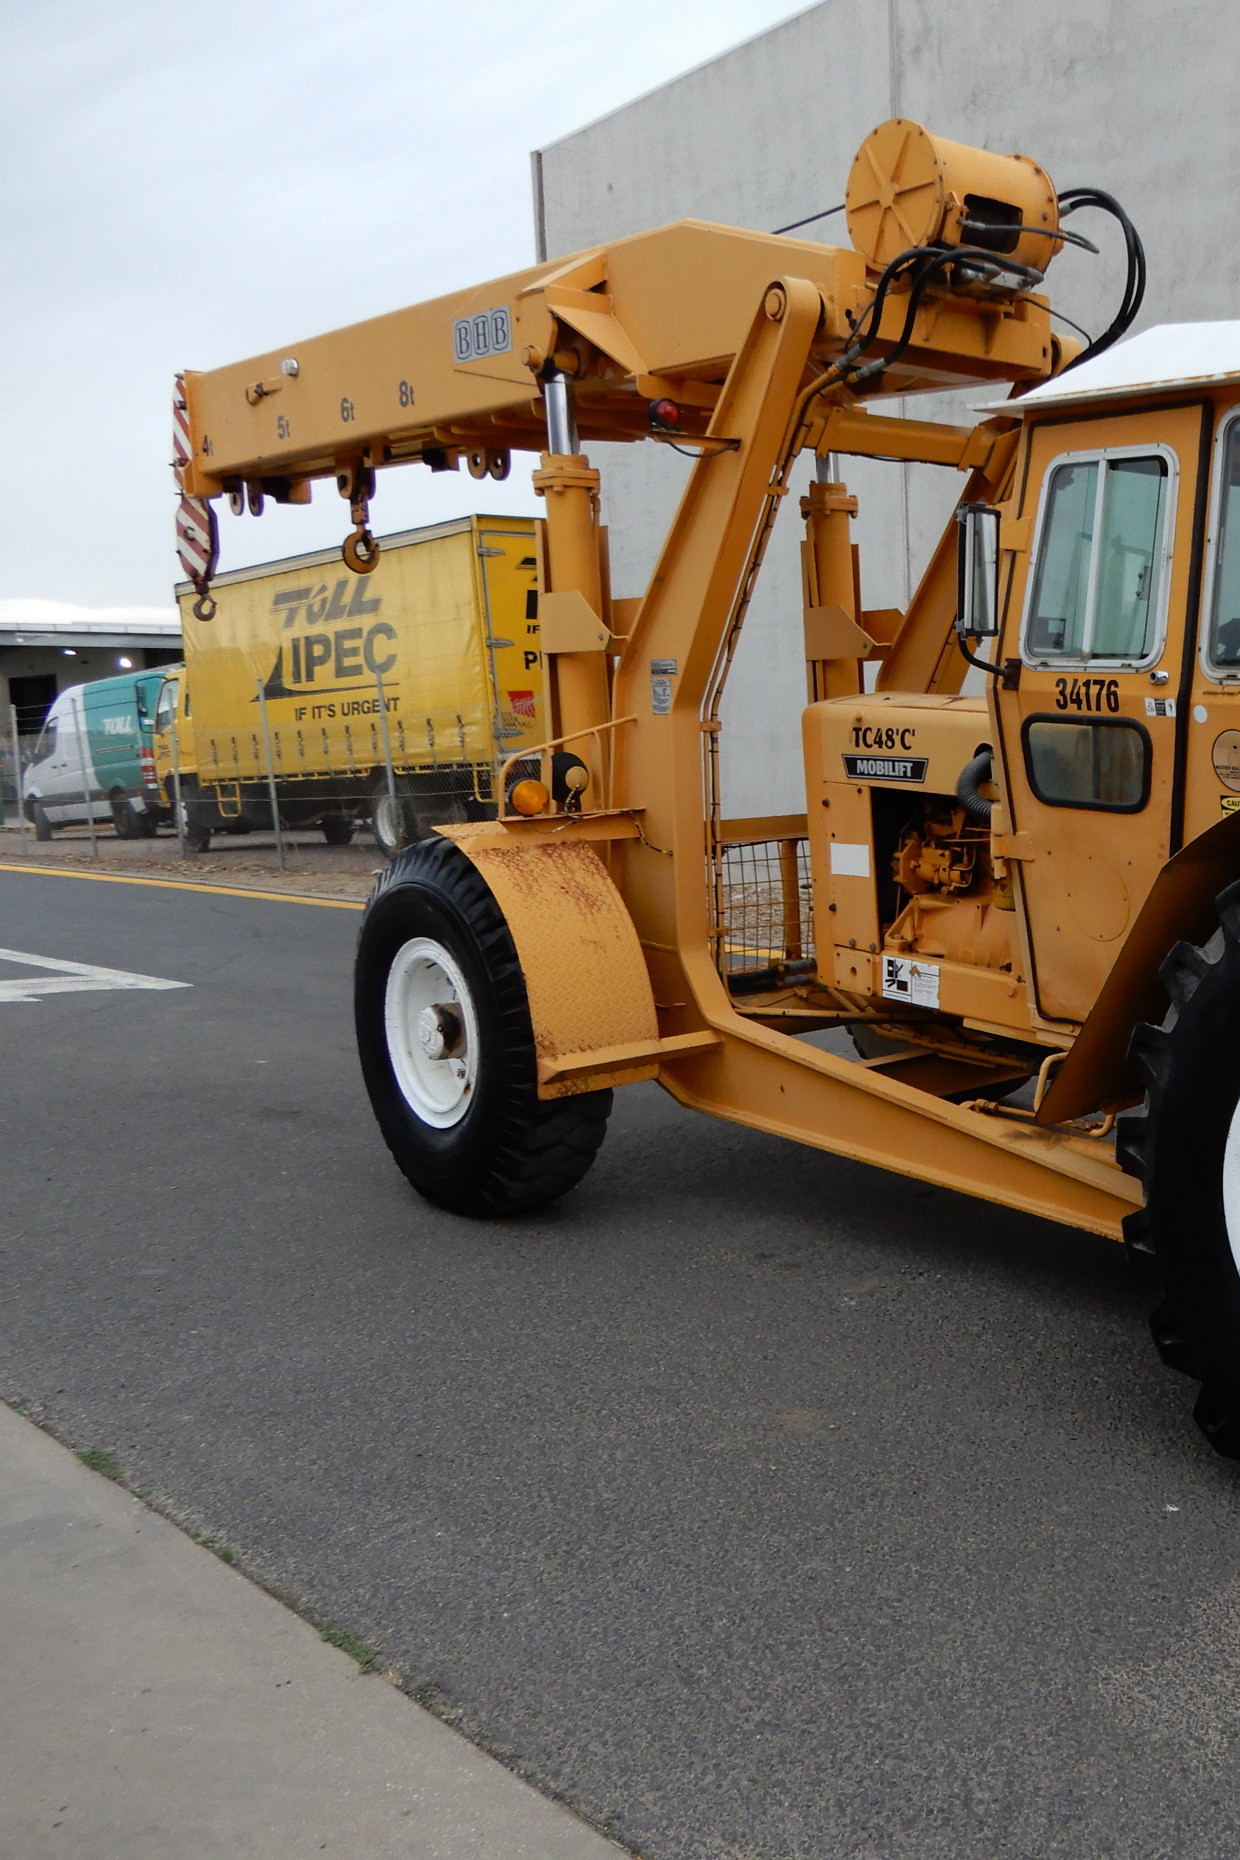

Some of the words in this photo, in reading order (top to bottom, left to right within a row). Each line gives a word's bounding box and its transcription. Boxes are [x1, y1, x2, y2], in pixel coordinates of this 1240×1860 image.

[456, 315, 508, 356] BHB
[399, 381, 414, 407] 8t
[341, 397, 354, 422] 6t
[277, 415, 291, 439] 5t
[271, 575, 383, 629] TOLL
[291, 622, 398, 684] IPEC
[1055, 678, 1120, 713] 34176
[295, 707, 306, 721] IF
[312, 704, 336, 719] IT'S
[852, 727, 915, 750] TC48'C'
[856, 760, 913, 777] MOBILIFT
